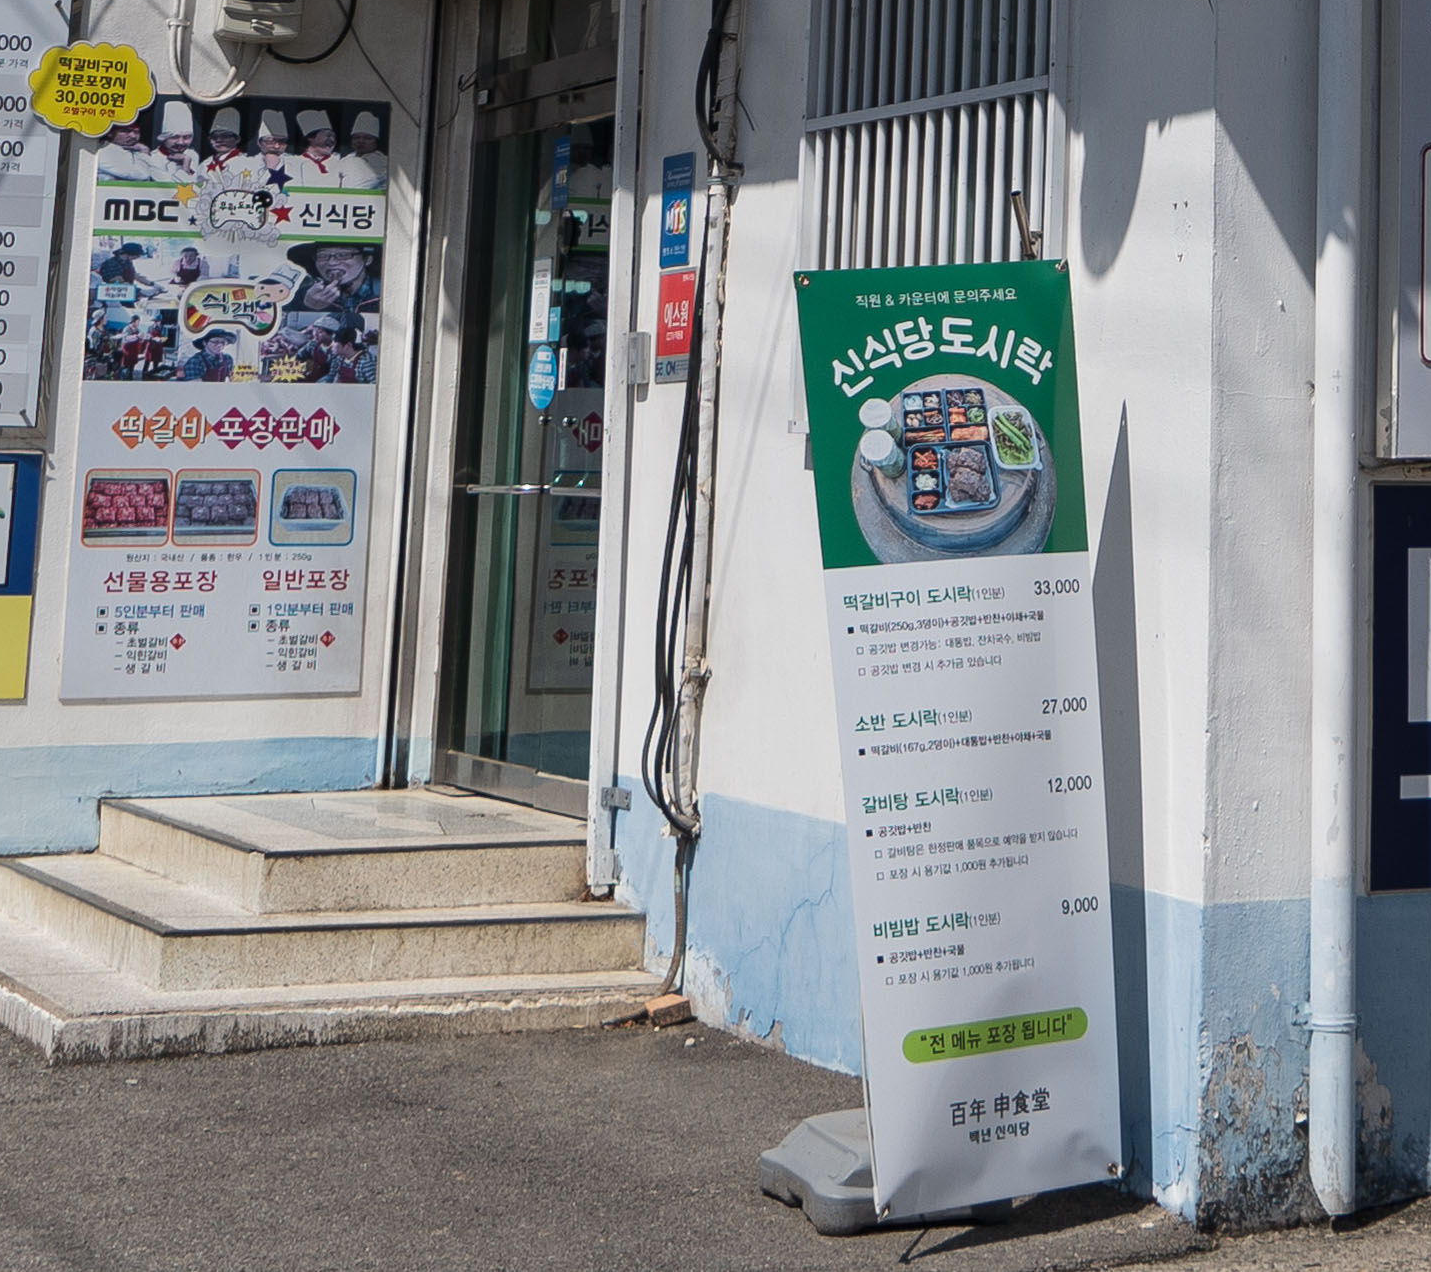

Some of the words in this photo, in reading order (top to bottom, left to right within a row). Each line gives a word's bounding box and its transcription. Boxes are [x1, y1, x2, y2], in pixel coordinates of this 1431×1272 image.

[8, 58, 29, 69] 가격
[58, 57, 128, 75] 떡갈비구이
[57, 73, 126, 90] 방문포장시
[55, 90, 125, 108] 30,000원
[104, 198, 180, 223] MBC
[299, 202, 376, 230] 신식당
[855, 294, 881, 308] 직원
[885, 294, 895, 306] &
[898, 291, 950, 306] 카운터에
[953, 288, 1017, 304] 문의주세요
[663, 300, 689, 327] 에스원
[832, 316, 936, 398] 신식당
[939, 316, 1054, 386] 도시락
[119, 415, 207, 445] 떡갈비
[219, 415, 336, 445] 포장판매
[103, 570, 218, 593] 선물용포장
[262, 569, 350, 591] 일반포장
[1034, 579, 1080, 596] 33,000
[843, 589, 920, 612] 떡갈비구이
[926, 585, 1006, 604] 도시락(1인분)
[114, 604, 175, 619] 5인분부터
[180, 603, 205, 618] 판매
[267, 603, 324, 617] 1인분부터
[329, 602, 354, 616] 판매
[114, 621, 139, 635] 종류
[266, 619, 290, 633] 종류
[126, 649, 167, 661] 익힌갈비
[1041, 697, 1088, 715] 27,000
[854, 714, 885, 732] 소반
[892, 709, 973, 729] 도시락(1인분)
[1047, 775, 1092, 794] 12,000
[861, 792, 908, 814] 갈비탕
[915, 787, 993, 808] 도시락(1인분)
[877, 822, 932, 837] 공깃밥+반찬
[1061, 896, 1098, 916] 9,000
[873, 918, 919, 939] 비빔밥
[926, 912, 1001, 933] 도시락(1인분)
[951, 1031, 981, 1051] 메뉴
[987, 1023, 1016, 1045] 포장
[950, 1098, 986, 1127] 百年
[994, 1087, 1051, 1119] 申食堂
[969, 1128, 991, 1144] 백년
